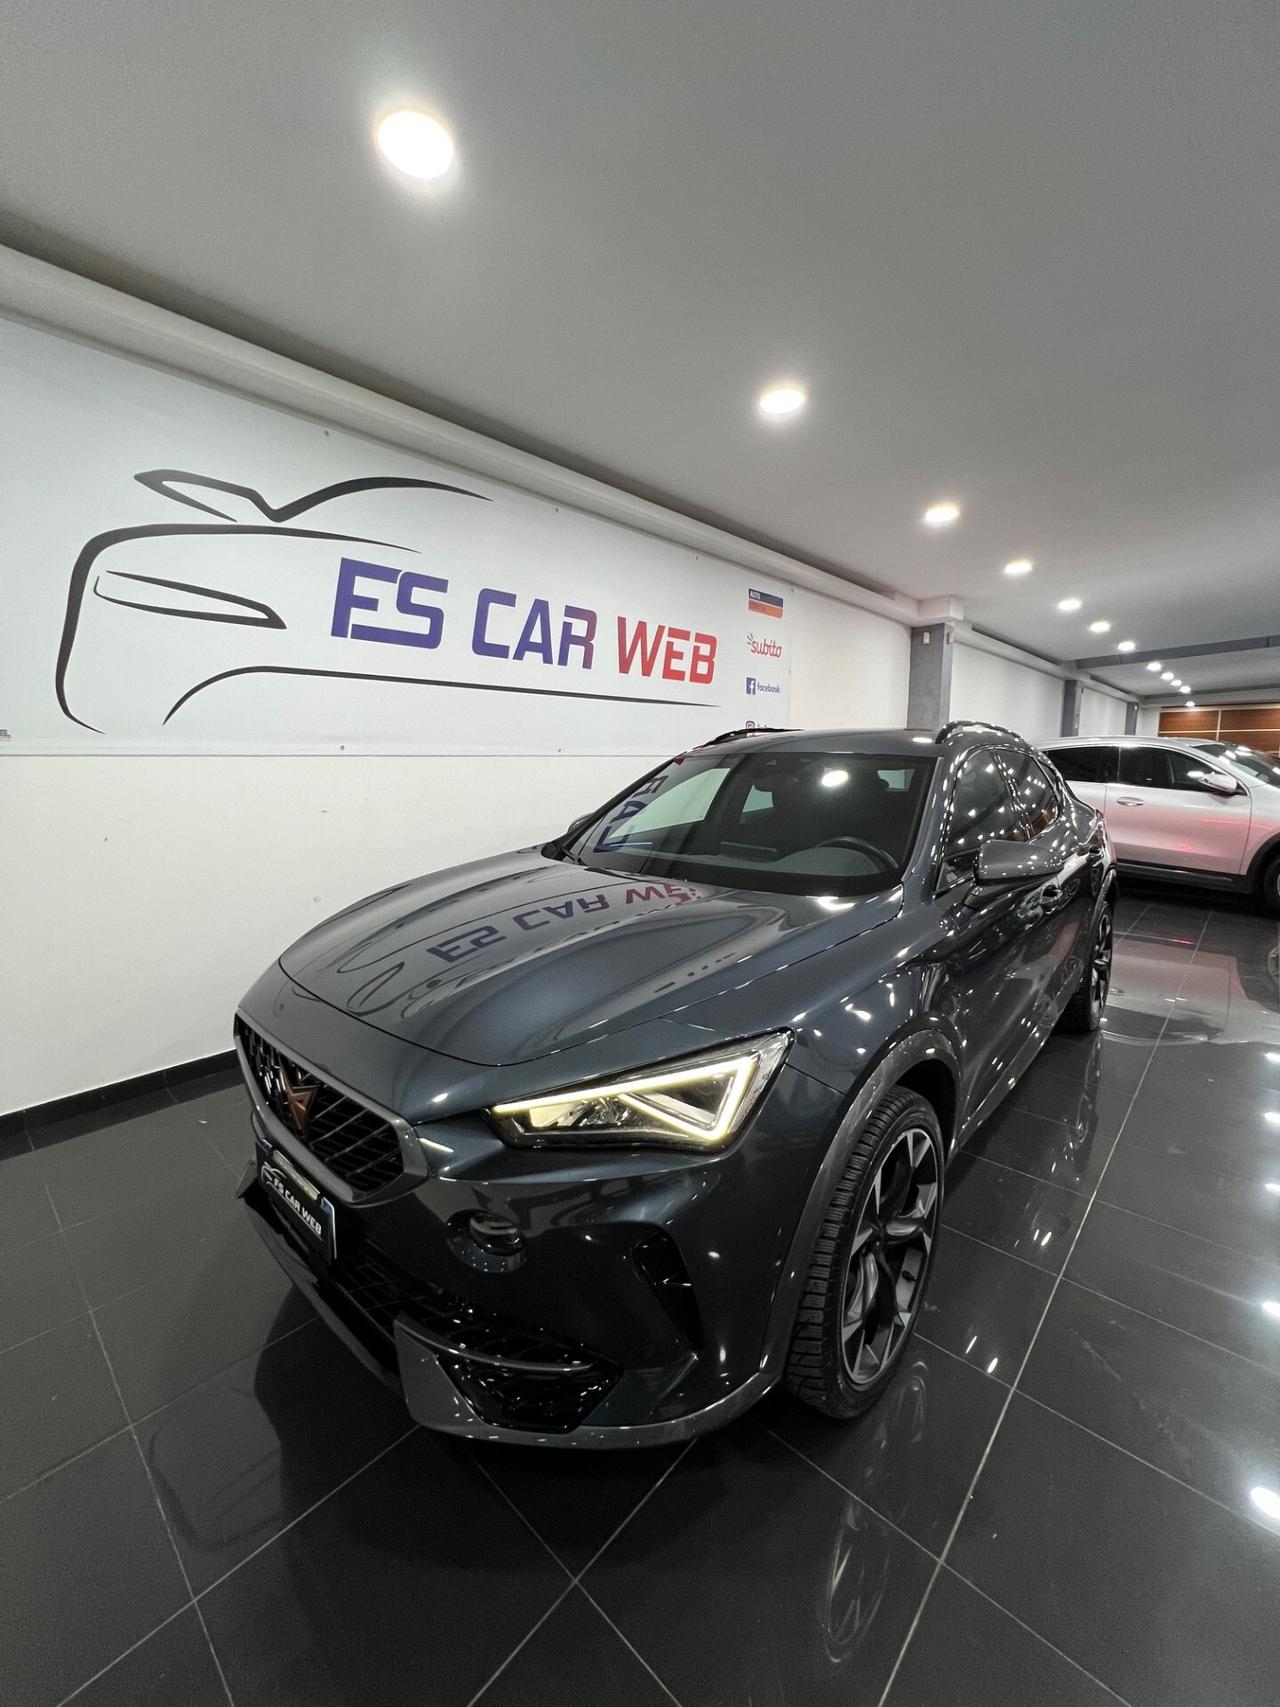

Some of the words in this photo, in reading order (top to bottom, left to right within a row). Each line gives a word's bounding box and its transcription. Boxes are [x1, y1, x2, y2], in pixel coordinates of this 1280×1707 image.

[331, 557, 449, 650] ES
[472, 588, 597, 670] CAR
[617, 616, 718, 685] WEB
[751, 638, 783, 658] subito
[757, 682, 780, 693] facebook
[285, 1190, 300, 1212] CAR
[302, 1207, 321, 1235] WEB
